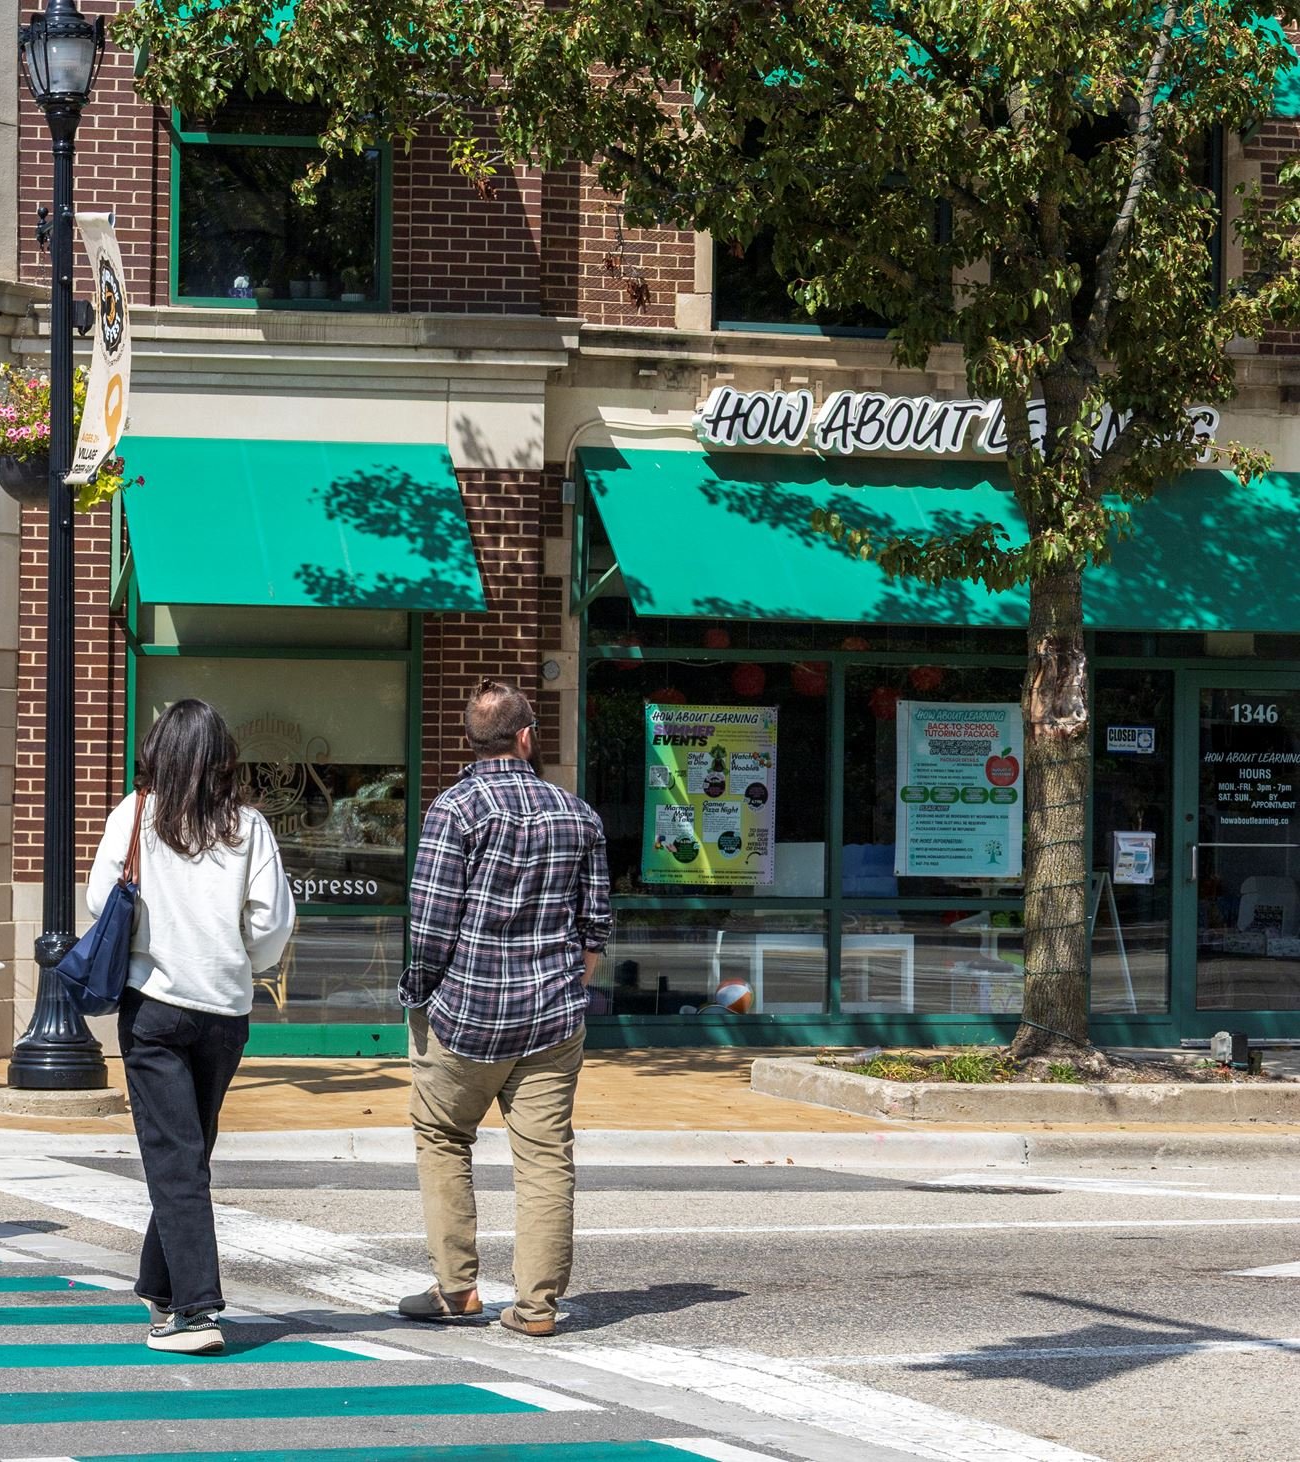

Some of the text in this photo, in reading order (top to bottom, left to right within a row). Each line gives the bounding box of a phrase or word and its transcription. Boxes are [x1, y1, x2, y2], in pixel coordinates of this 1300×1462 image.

[705, 391, 809, 441] HOW
[820, 395, 983, 449] ABOUT
[652, 711, 759, 724] HOW ABOUT LEARNING
[917, 709, 1005, 721] HOW ABOUT LEARNING
[1230, 704, 1278, 723] 1346
[654, 725, 715, 736] SUMMER
[927, 723, 996, 731] BACK-TO-SCHOOL
[963, 730, 999, 738] PACKAGE
[1108, 729, 1136, 742] CLOSED
[652, 735, 708, 746] EVENTS
[1204, 751, 1225, 763] HOW
[1226, 752, 1258, 763] ABOUT
[1239, 768, 1272, 779] HOURS
[1218, 783, 1254, 791] MON.-FRI.
[1257, 783, 1272, 792] 3pm
[1277, 783, 1292, 792] 7pm
[1218, 793, 1278, 801] SAT. SUN. BY
[1220, 816, 1289, 826] howaboutlearning.co
